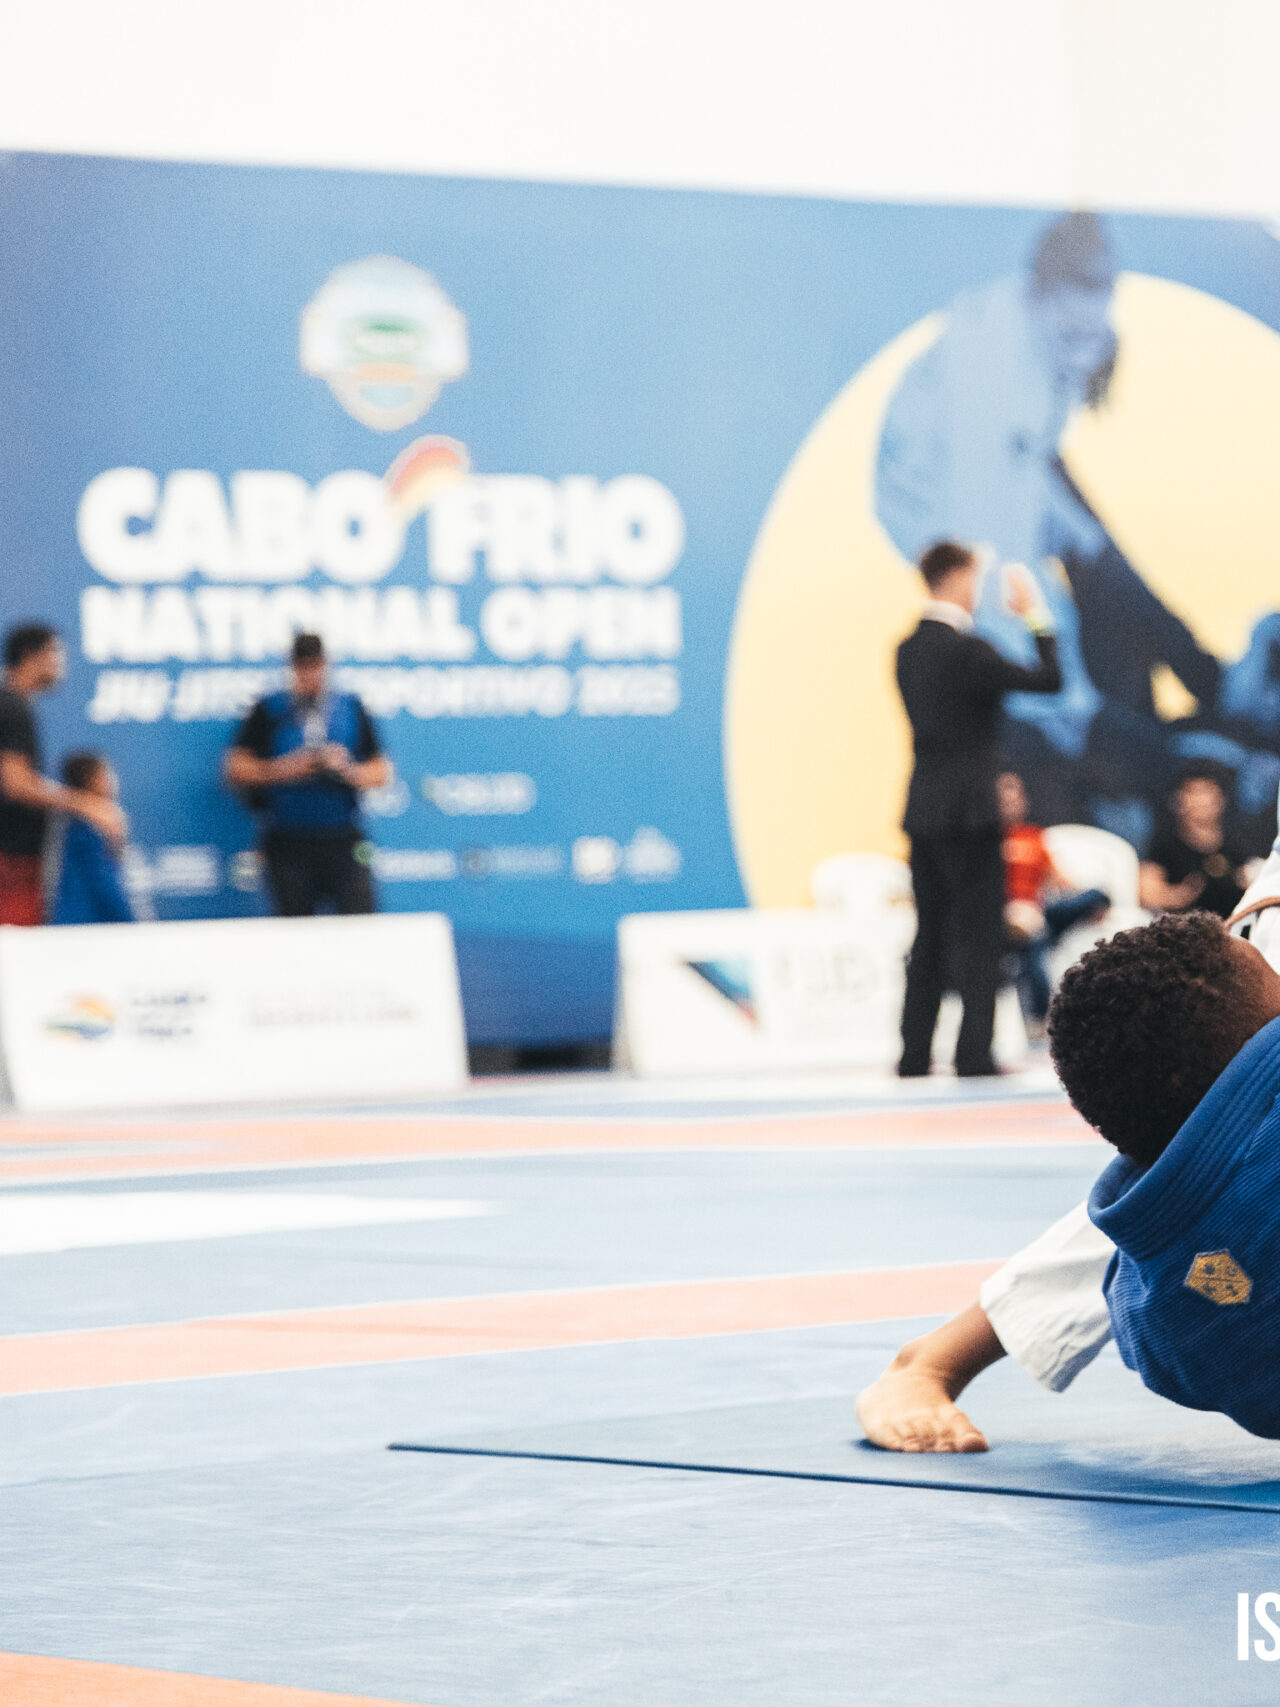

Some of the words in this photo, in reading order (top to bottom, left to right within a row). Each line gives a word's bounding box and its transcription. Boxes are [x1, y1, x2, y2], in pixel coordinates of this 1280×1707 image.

[78, 467, 405, 584] CABO
[426, 473, 685, 585] FRIO
[81, 585, 474, 662] NATIONAL
[481, 586, 683, 661] OPEN
